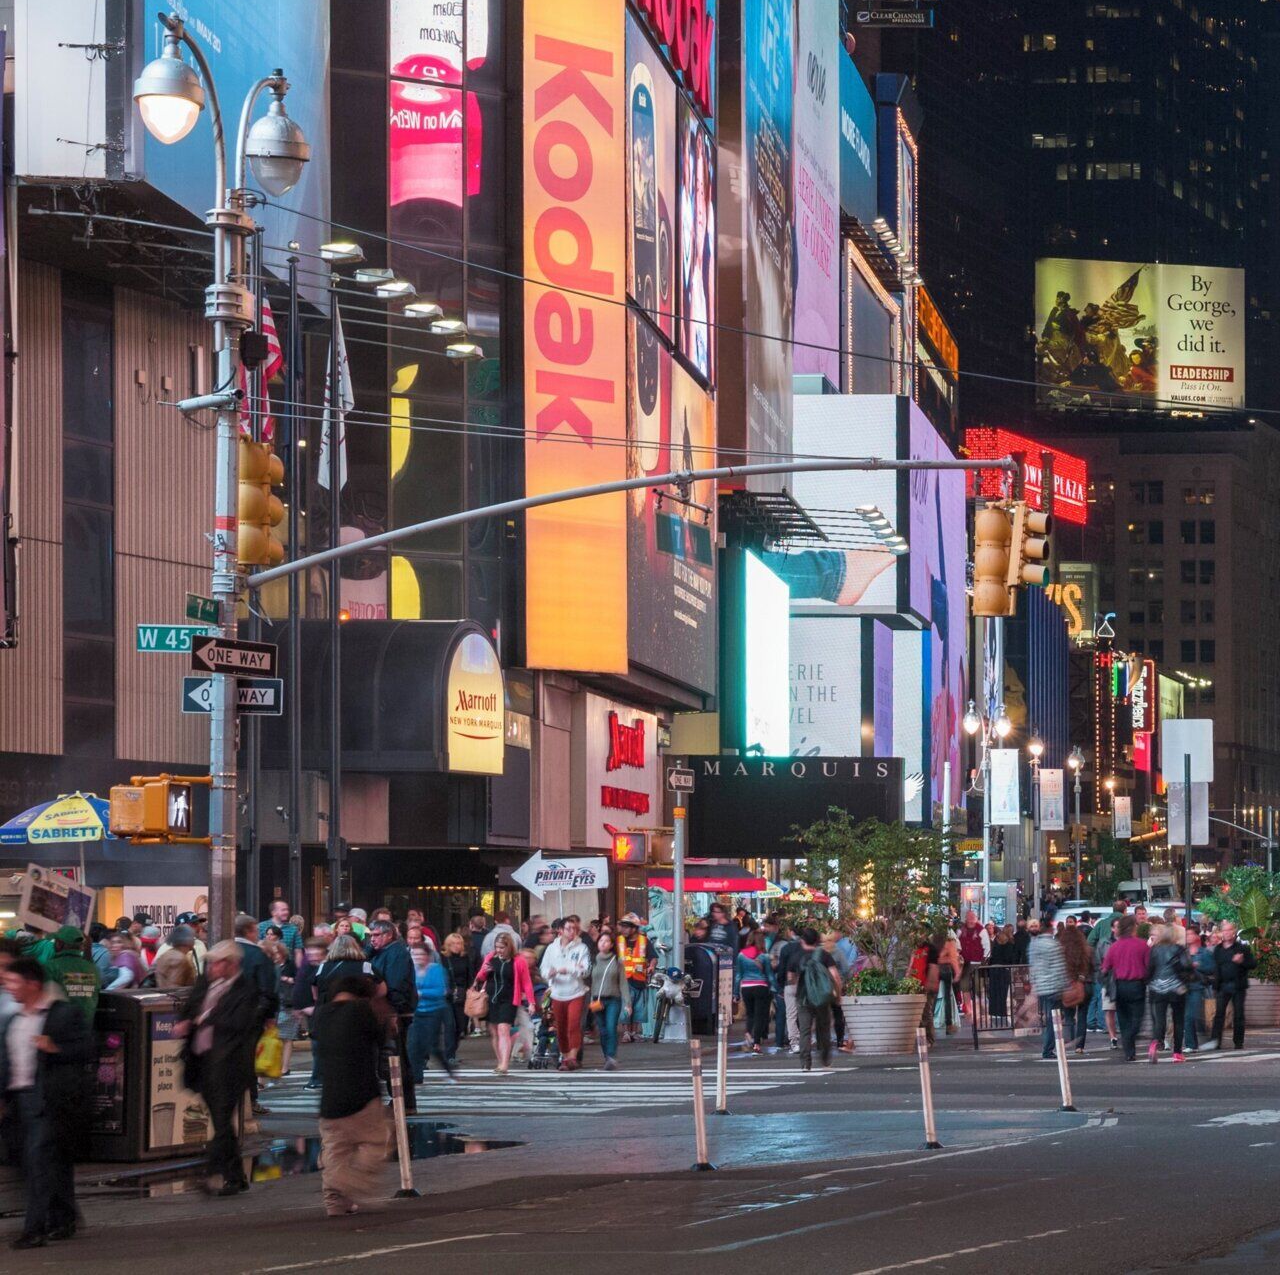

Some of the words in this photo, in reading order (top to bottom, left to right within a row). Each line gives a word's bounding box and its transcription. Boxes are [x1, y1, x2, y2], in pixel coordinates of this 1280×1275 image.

[534, 34, 615, 451] Kodak
[1191, 275, 1213, 296] By
[1167, 294, 1236, 317] George,
[1189, 319, 1214, 332] we
[1177, 334, 1205, 353] did
[1209, 336, 1226, 353] it.
[1171, 367, 1231, 381] LEADERSHIP
[1180, 381, 1198, 392] Pass
[1206, 382, 1223, 393] On.
[1054, 473, 1084, 502] PLAZA
[139, 629, 158, 648] W
[165, 629, 190, 649] 45
[207, 648, 233, 663] ONE
[239, 650, 265, 667] WAY
[239, 689, 268, 703] WAY
[455, 689, 497, 712] Marriott
[807, 685, 838, 702] THE
[450, 716, 459, 725] NEW
[463, 716, 477, 726] YORK
[703, 760, 888, 778] MARQUIS
[44, 808, 89, 821] SABRETT
[31, 827, 98, 840] SABRETT
[535, 870, 573, 883] PRIVATE
[572, 874, 596, 888] EYES
[149, 905, 161, 923] OUR
[156, 1021, 172, 1034] Keep
